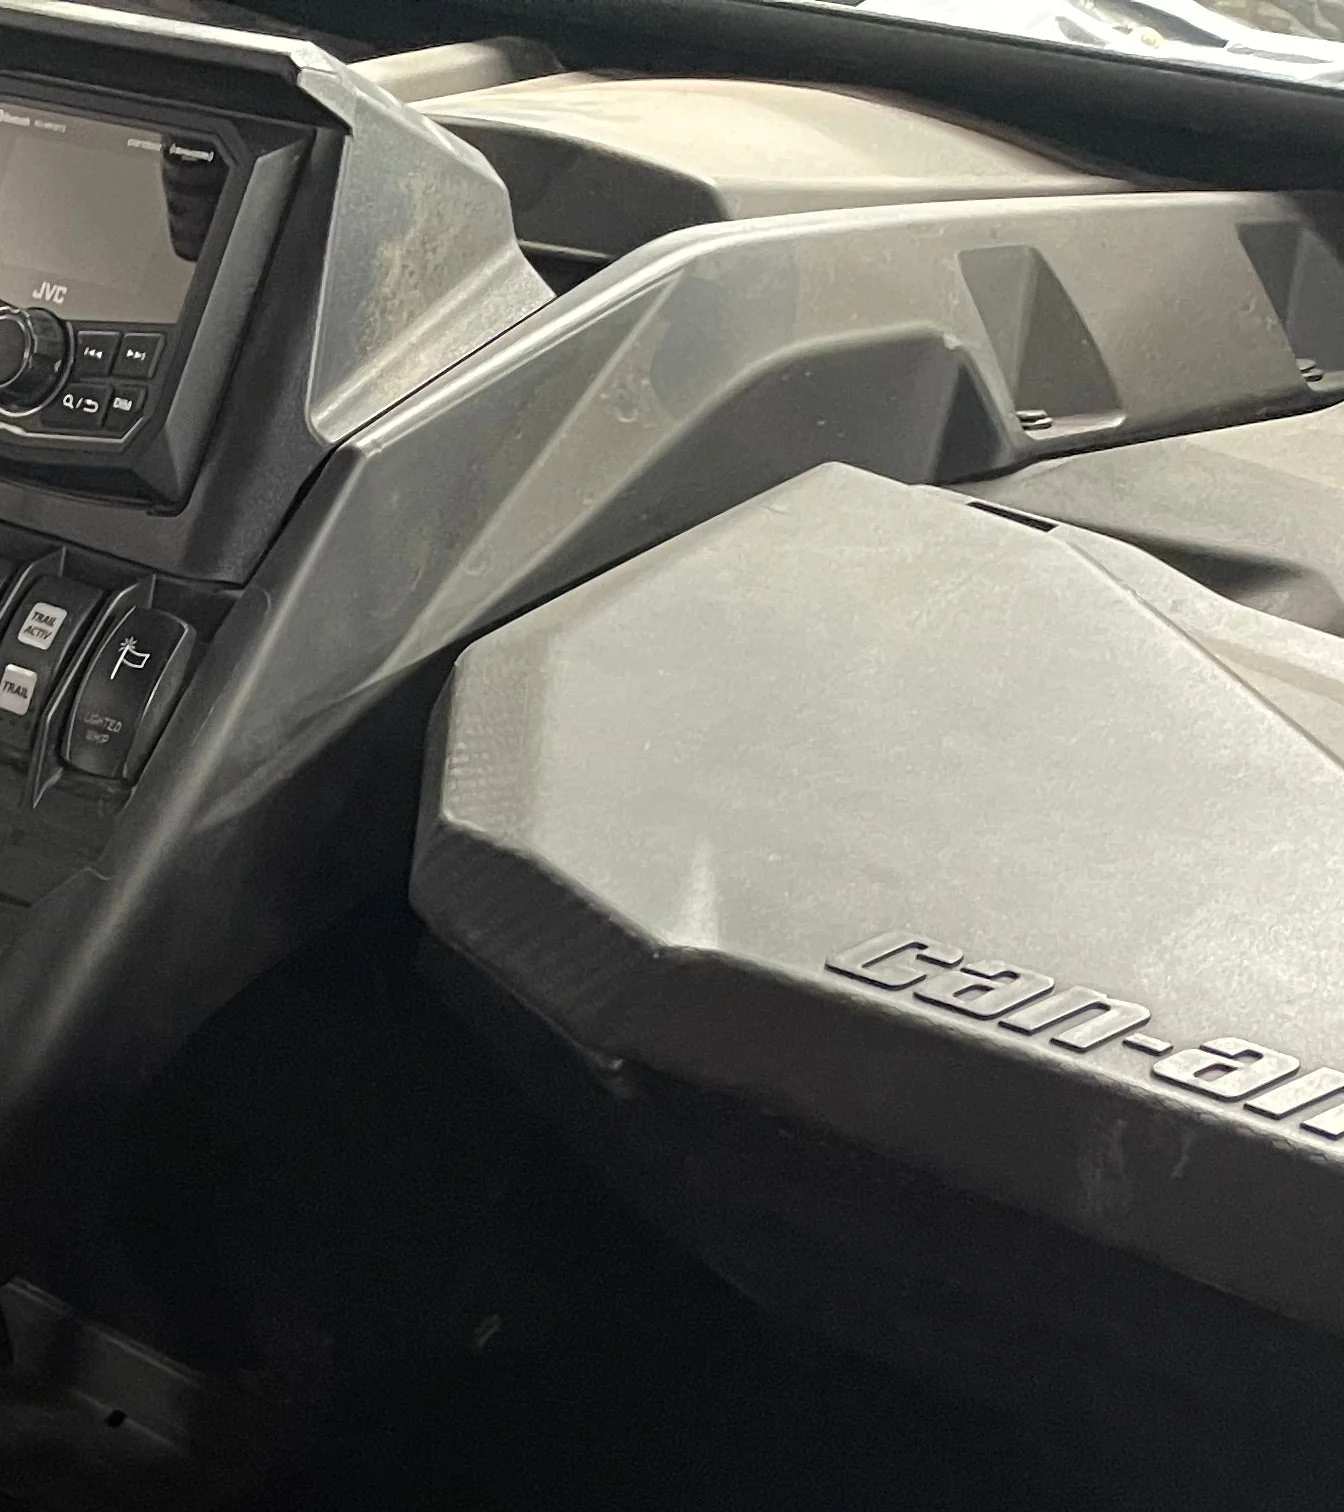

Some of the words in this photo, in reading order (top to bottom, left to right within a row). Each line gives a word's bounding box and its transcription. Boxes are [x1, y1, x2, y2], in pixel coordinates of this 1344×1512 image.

[32, 282, 68, 303] JVC
[32, 611, 57, 627] TRAIL
[23, 625, 52, 640] ACTIV
[3, 681, 29, 699] TRAIL
